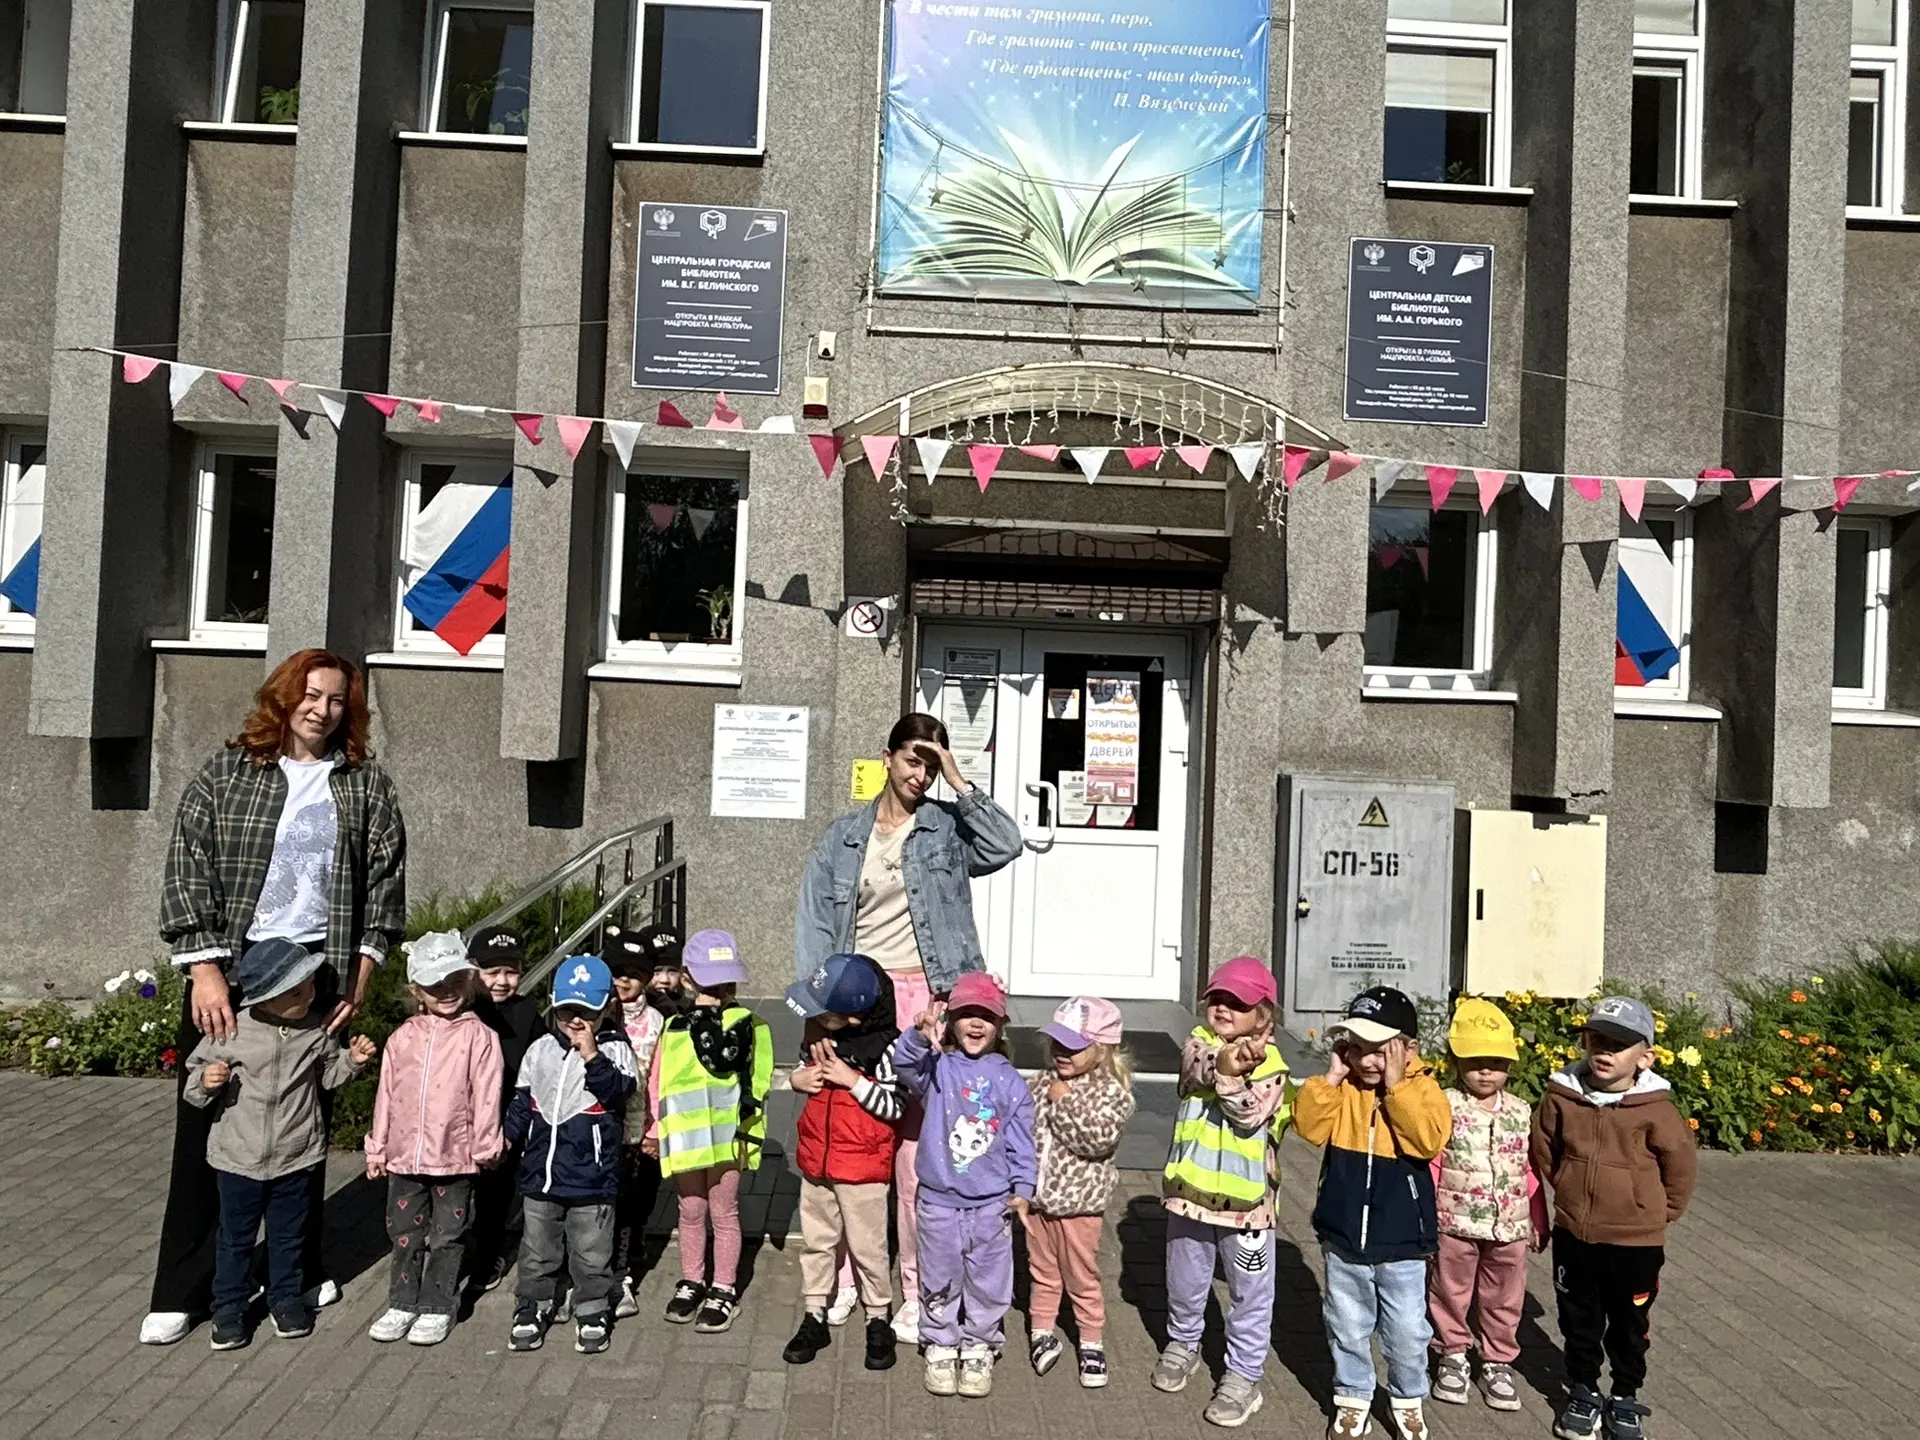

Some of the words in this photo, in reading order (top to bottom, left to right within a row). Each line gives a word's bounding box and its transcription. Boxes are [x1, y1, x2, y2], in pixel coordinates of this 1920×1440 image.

[926, 2, 980, 18] чести
[984, 5, 1021, 19] там
[1025, 8, 1105, 25] грамота,
[1110, 12, 1153, 28] перо,
[964, 29, 996, 46] Где
[1000, 33, 1074, 50] грамота
[1090, 38, 1128, 53] там
[1132, 41, 1244, 60] просвещенье,
[1022, 61, 1132, 81] просвещенье
[1147, 69, 1184, 84] там
[1189, 69, 1251, 88] добро.»
[1112, 92, 1130, 108] И.
[1138, 93, 1230, 113] Вяземский
[651, 254, 716, 267] ЦЕНТРАЛЬНАЯ
[718, 258, 771, 270] ГОРОДСКАЯ
[681, 268, 741, 280] БИБЛИОТЕКА
[661, 279, 679, 289] ИМ.
[681, 280, 696, 290] В.Г.
[698, 281, 759, 293] БЕЛИНСКОГО
[1369, 290, 1431, 302] ЦЕНТРАЛЬНАЯ
[1433, 293, 1471, 304] ДЕТСКАЯ
[1391, 303, 1449, 314] БИБЛИОТЕКА
[675, 312, 707, 321] ОТКРЫТА
[1376, 313, 1393, 323] ИМ.
[1395, 315, 1414, 324] А.М.
[1416, 316, 1463, 327] ГОРЬКОГО
[664, 319, 709, 329] НАЦПРОЕКТА
[710, 321, 752, 330] «КУЛЬТУРА»
[1385, 346, 1416, 355] ОТКРЫТА
[1423, 348, 1450, 356] РАМКАХ
[1380, 353, 1425, 362] НАЦПРОЕКТА
[1425, 355, 1455, 363] «СЕМЬЯ»
[1087, 719, 1138, 729] ОТКРЫТЫХ
[1090, 746, 1133, 758] ДВЕРЕЙ
